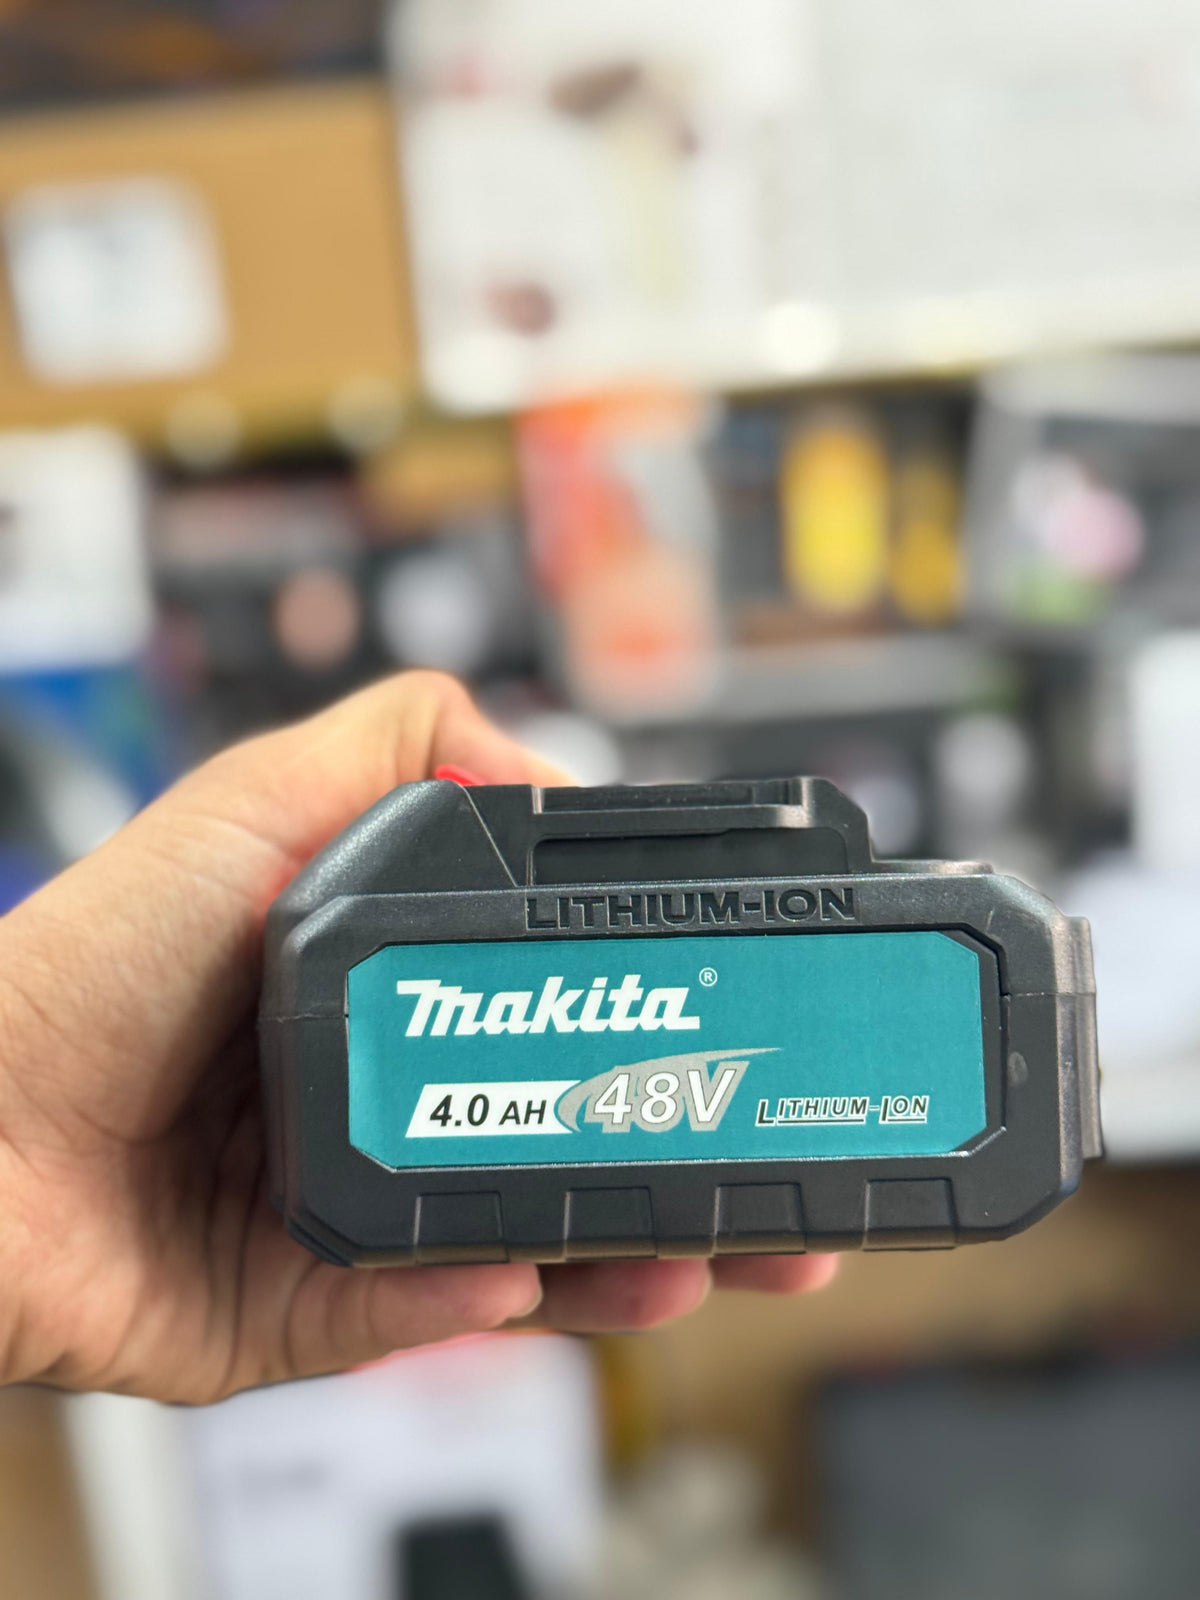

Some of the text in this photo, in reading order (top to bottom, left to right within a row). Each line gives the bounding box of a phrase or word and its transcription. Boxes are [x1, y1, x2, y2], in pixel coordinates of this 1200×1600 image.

[525, 887, 856, 931] LITHIUM-ION
[429, 1094, 546, 1127] 4.0 AH
[591, 1062, 747, 1131] 48V
[755, 1094, 931, 1127] LITHIUM-ION
